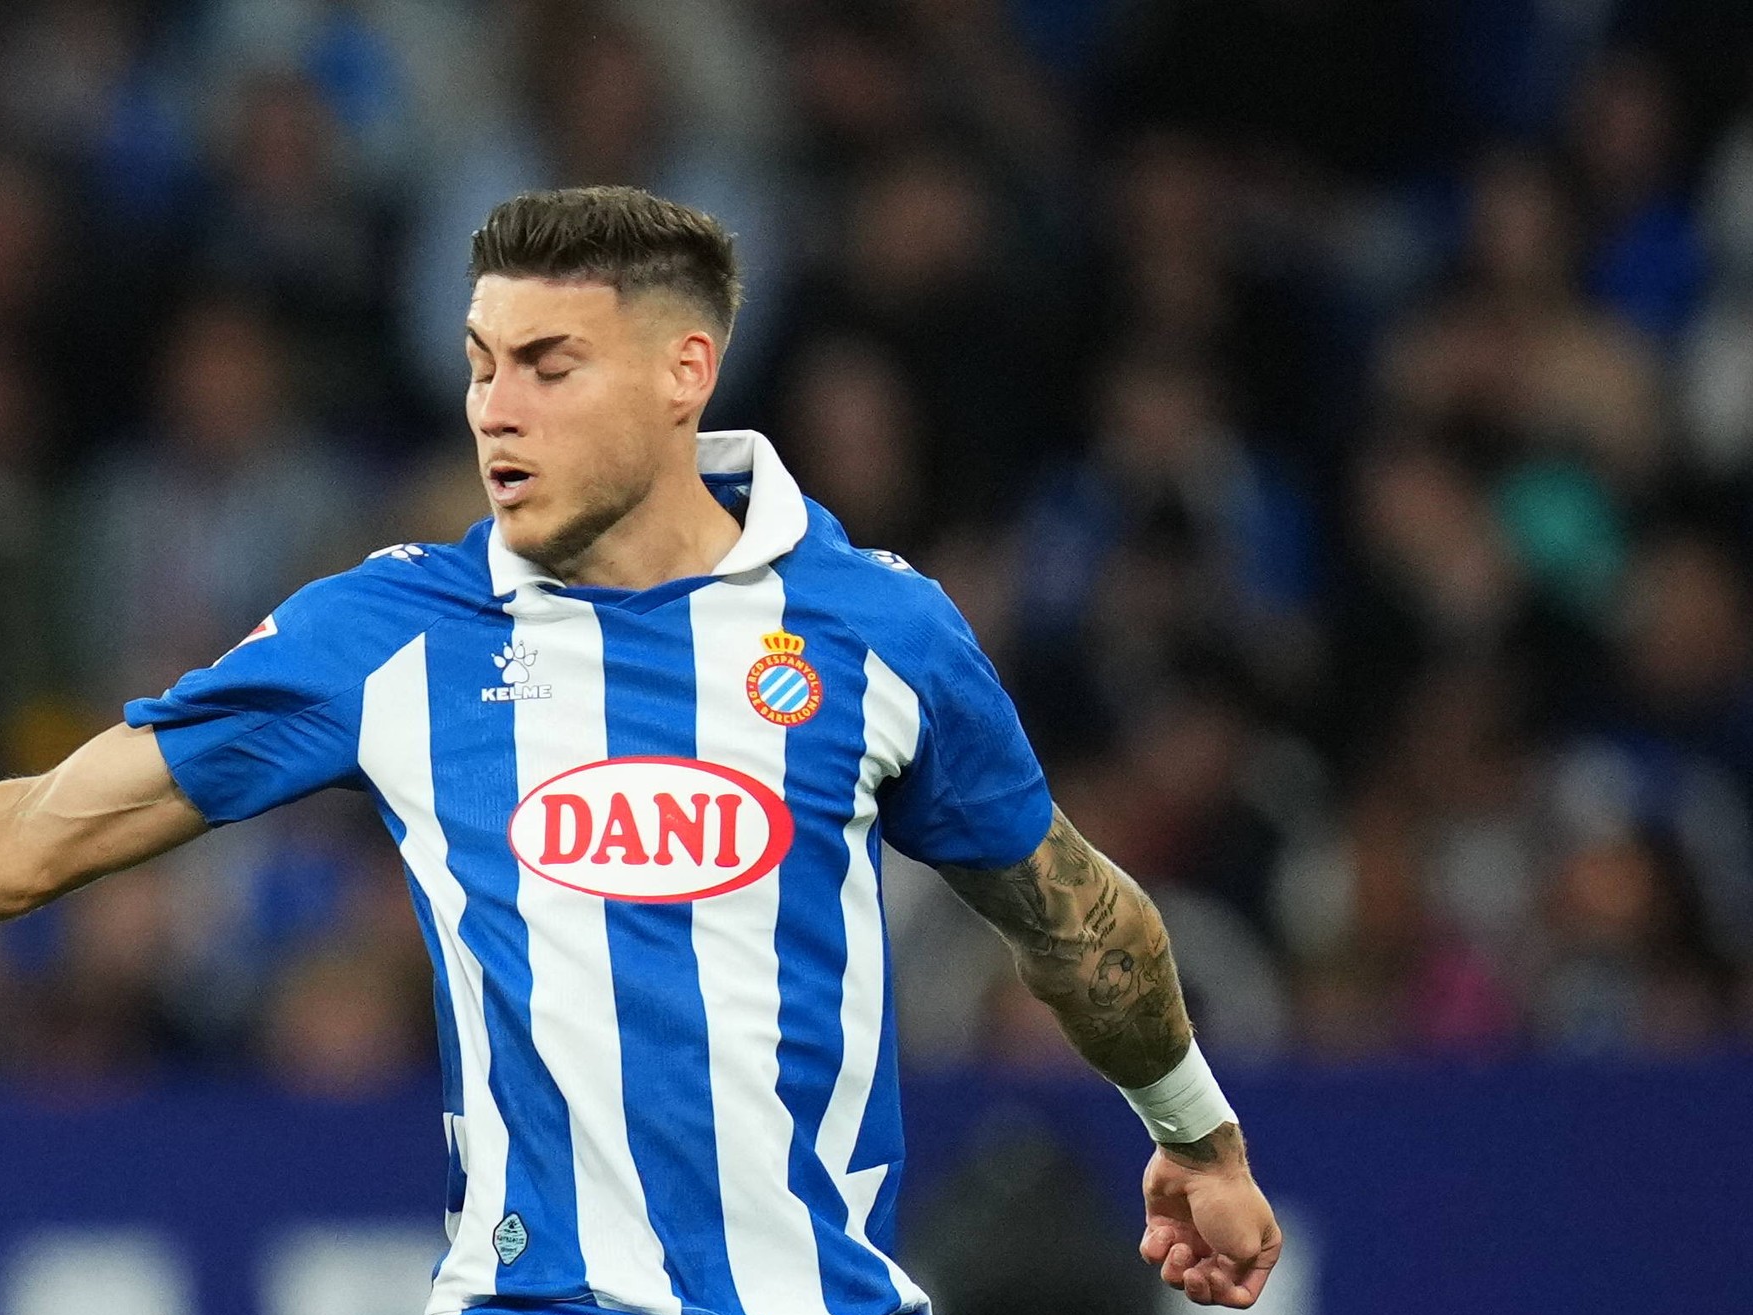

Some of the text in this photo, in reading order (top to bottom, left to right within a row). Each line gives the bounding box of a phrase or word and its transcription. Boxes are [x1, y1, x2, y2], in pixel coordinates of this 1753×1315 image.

[748, 655, 819, 685] RCD ESPANYOL
[481, 684, 552, 702] KELME
[760, 695, 820, 724] BARCELONA
[539, 792, 742, 868] DANI
